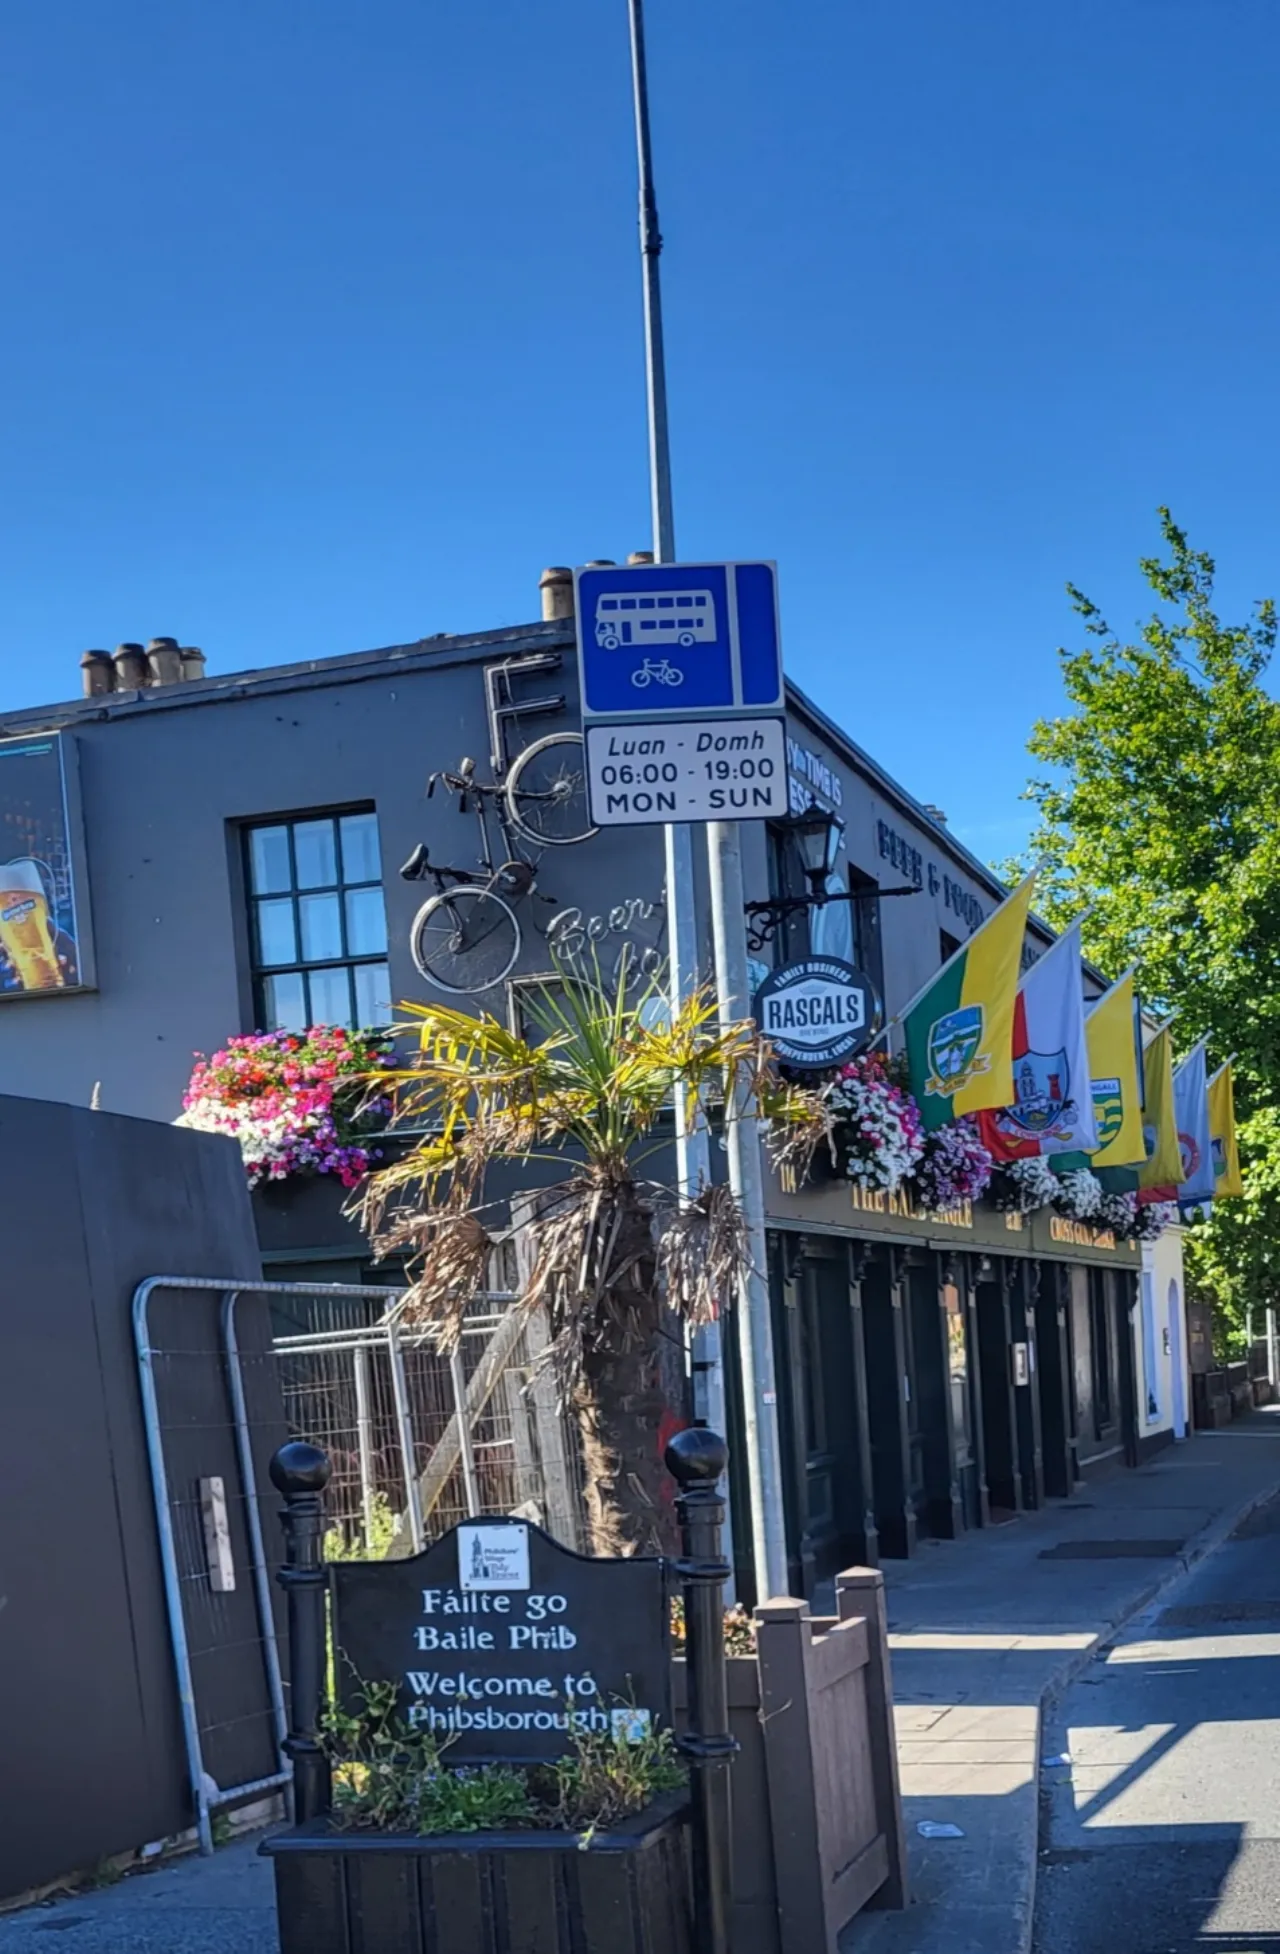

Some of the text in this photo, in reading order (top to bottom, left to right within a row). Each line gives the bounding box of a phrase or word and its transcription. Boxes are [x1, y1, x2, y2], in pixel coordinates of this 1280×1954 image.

[608, 737, 665, 756] Luan
[696, 730, 764, 752] Domh
[601, 763, 678, 785] 06:00
[704, 758, 774, 780] 19:00
[606, 791, 676, 814] MON
[708, 787, 772, 809] SUN
[545, 898, 653, 960] Beer
[774, 962, 852, 988] FAMILY BUSINESS
[768, 994, 859, 1029] RASCALS
[831, 1035, 858, 1056] LOCAL
[422, 1589, 567, 1620] Fáilte go
[416, 1625, 577, 1650] Baile Phib
[406, 1671, 597, 1696] Welcome to
[408, 1705, 608, 1736] Phibsborough
